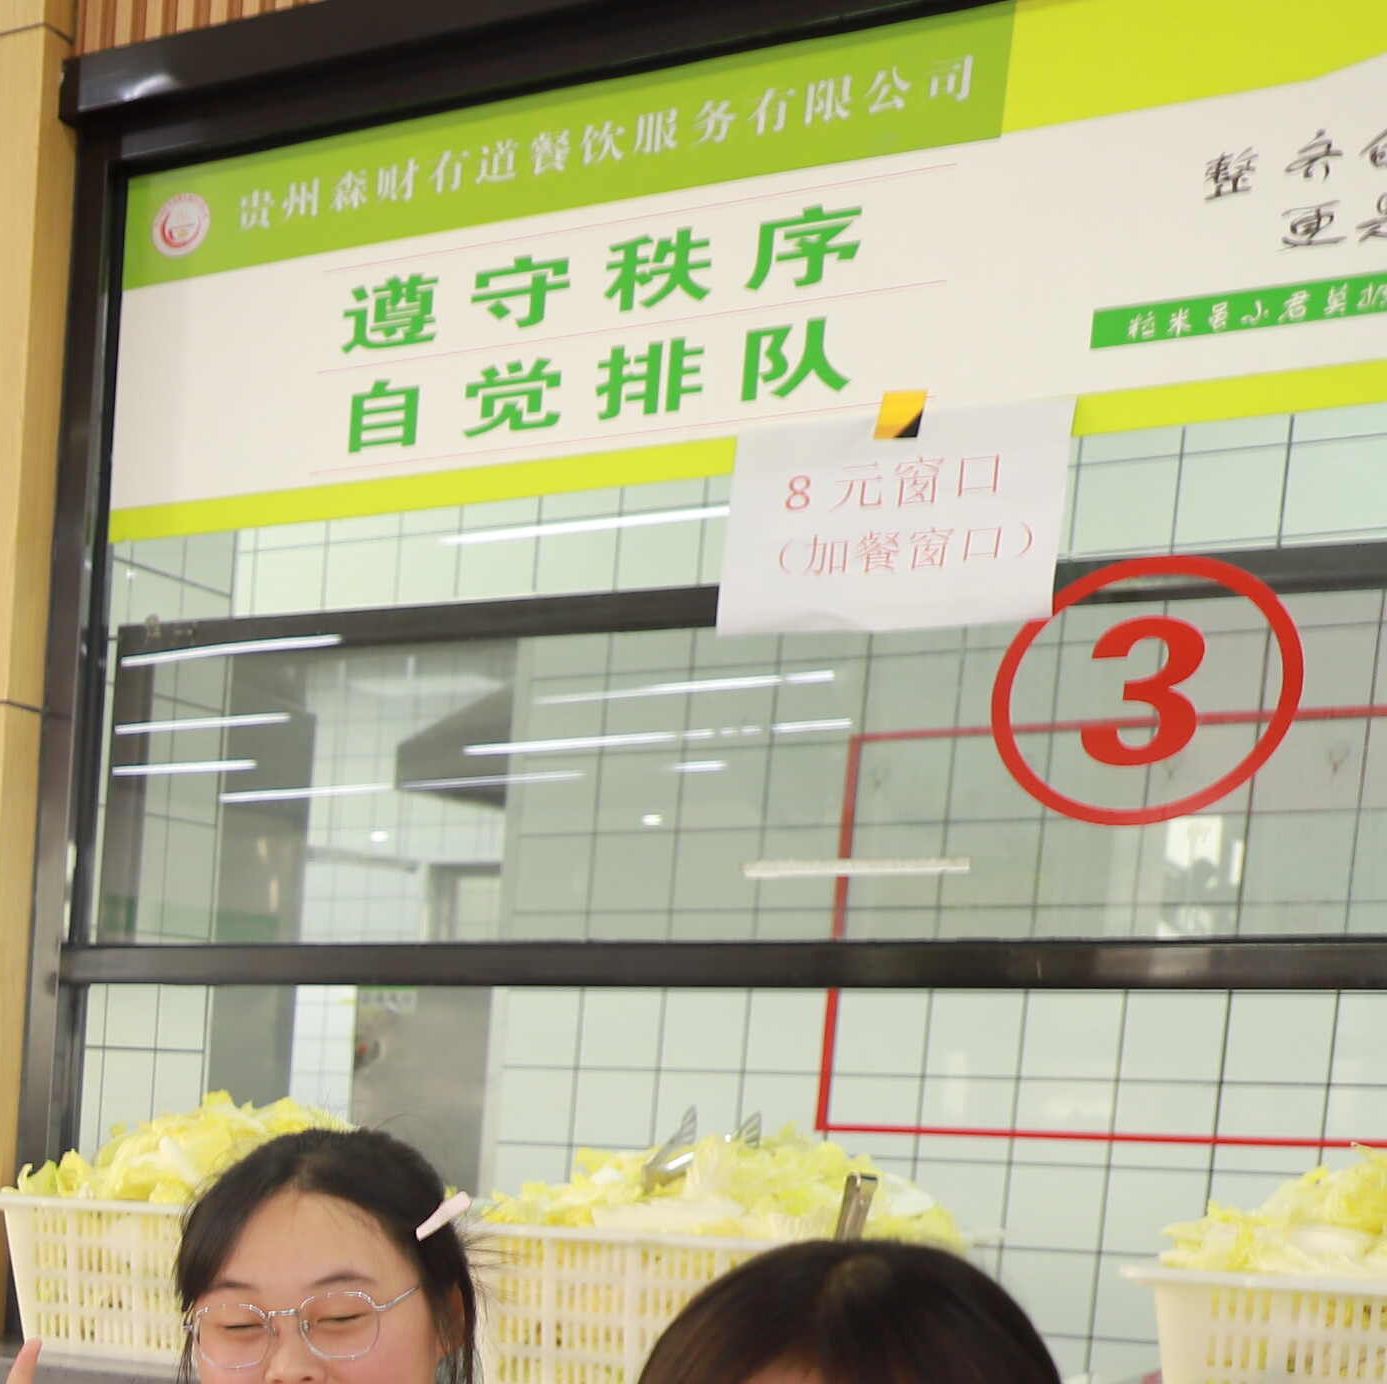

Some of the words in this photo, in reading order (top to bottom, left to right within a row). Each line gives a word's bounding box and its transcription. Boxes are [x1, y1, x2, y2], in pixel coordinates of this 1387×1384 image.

[237, 54, 974, 231] 贵州森财有道餐饮服务有限公司
[341, 204, 863, 354] 遵守秩序
[348, 316, 851, 454] 自觉排队
